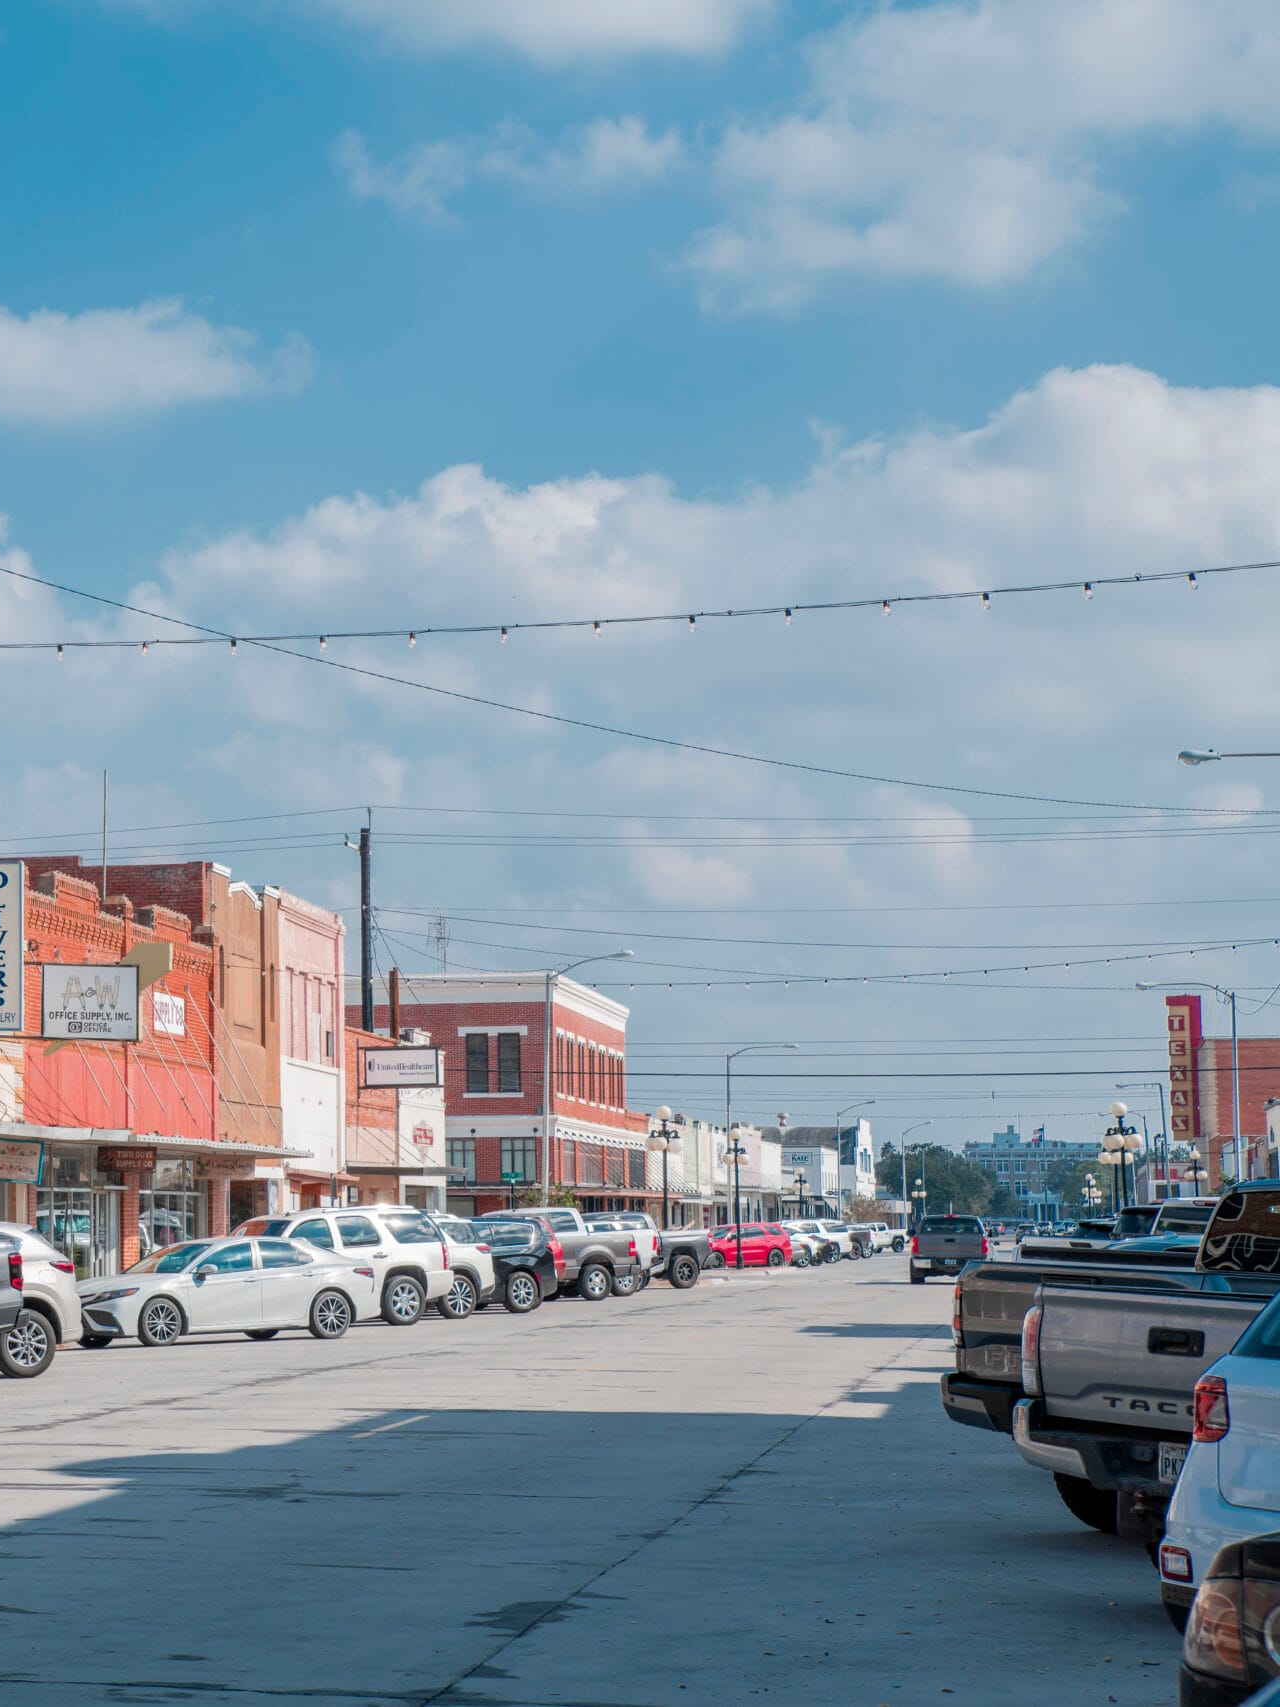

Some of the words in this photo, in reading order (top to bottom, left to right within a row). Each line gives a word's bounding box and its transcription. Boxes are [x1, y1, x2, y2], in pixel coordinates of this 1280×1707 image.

[48, 1011, 78, 1021] OFFICE
[80, 1011, 112, 1022] SUPPLY,
[115, 1012, 132, 1021] INC.
[377, 1062, 434, 1071] UnitedHealthcare
[1169, 1016, 1188, 1130] TEXAS
[118, 1150, 134, 1158] TWO
[135, 1150, 153, 1158] DOVE
[115, 1160, 141, 1168] SUPPLY
[143, 1160, 153, 1168] CO
